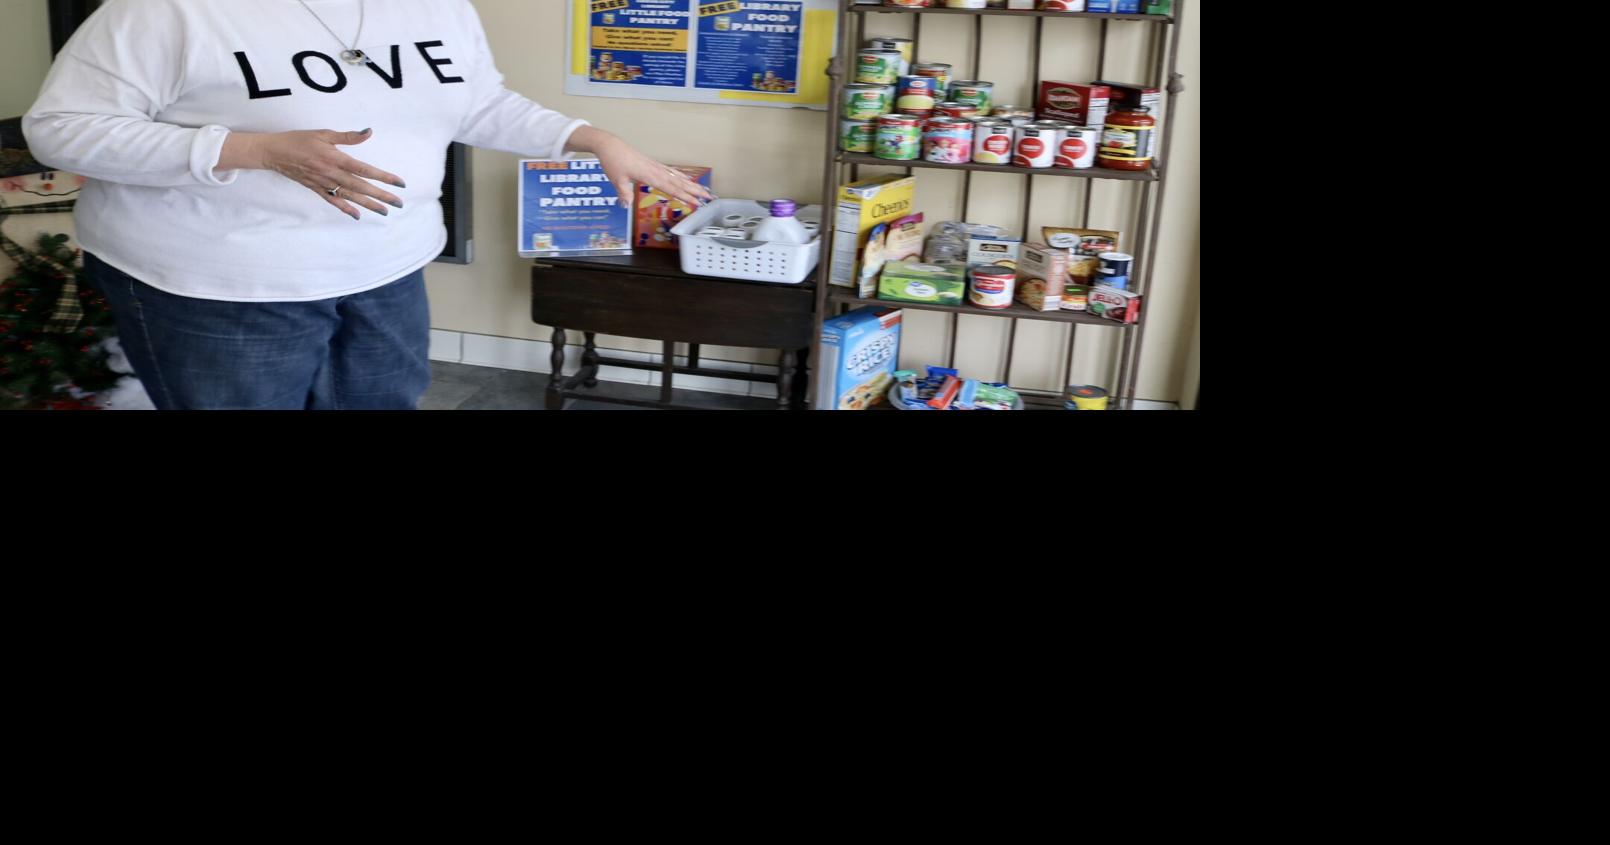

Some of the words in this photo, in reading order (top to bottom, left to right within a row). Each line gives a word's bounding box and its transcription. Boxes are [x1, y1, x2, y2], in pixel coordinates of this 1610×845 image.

[699, 2, 737, 15] FREE
[740, 3, 800, 11] LIBRARY
[629, 17, 679, 25] PANTRY
[747, 13, 790, 22] FOOD
[731, 22, 798, 33] PANTRY
[233, 40, 464, 99] LOVE
[527, 162, 568, 171] FREE
[551, 186, 602, 196] FOOD
[540, 197, 619, 207] PANTRY
[856, 346, 893, 377] RICE
